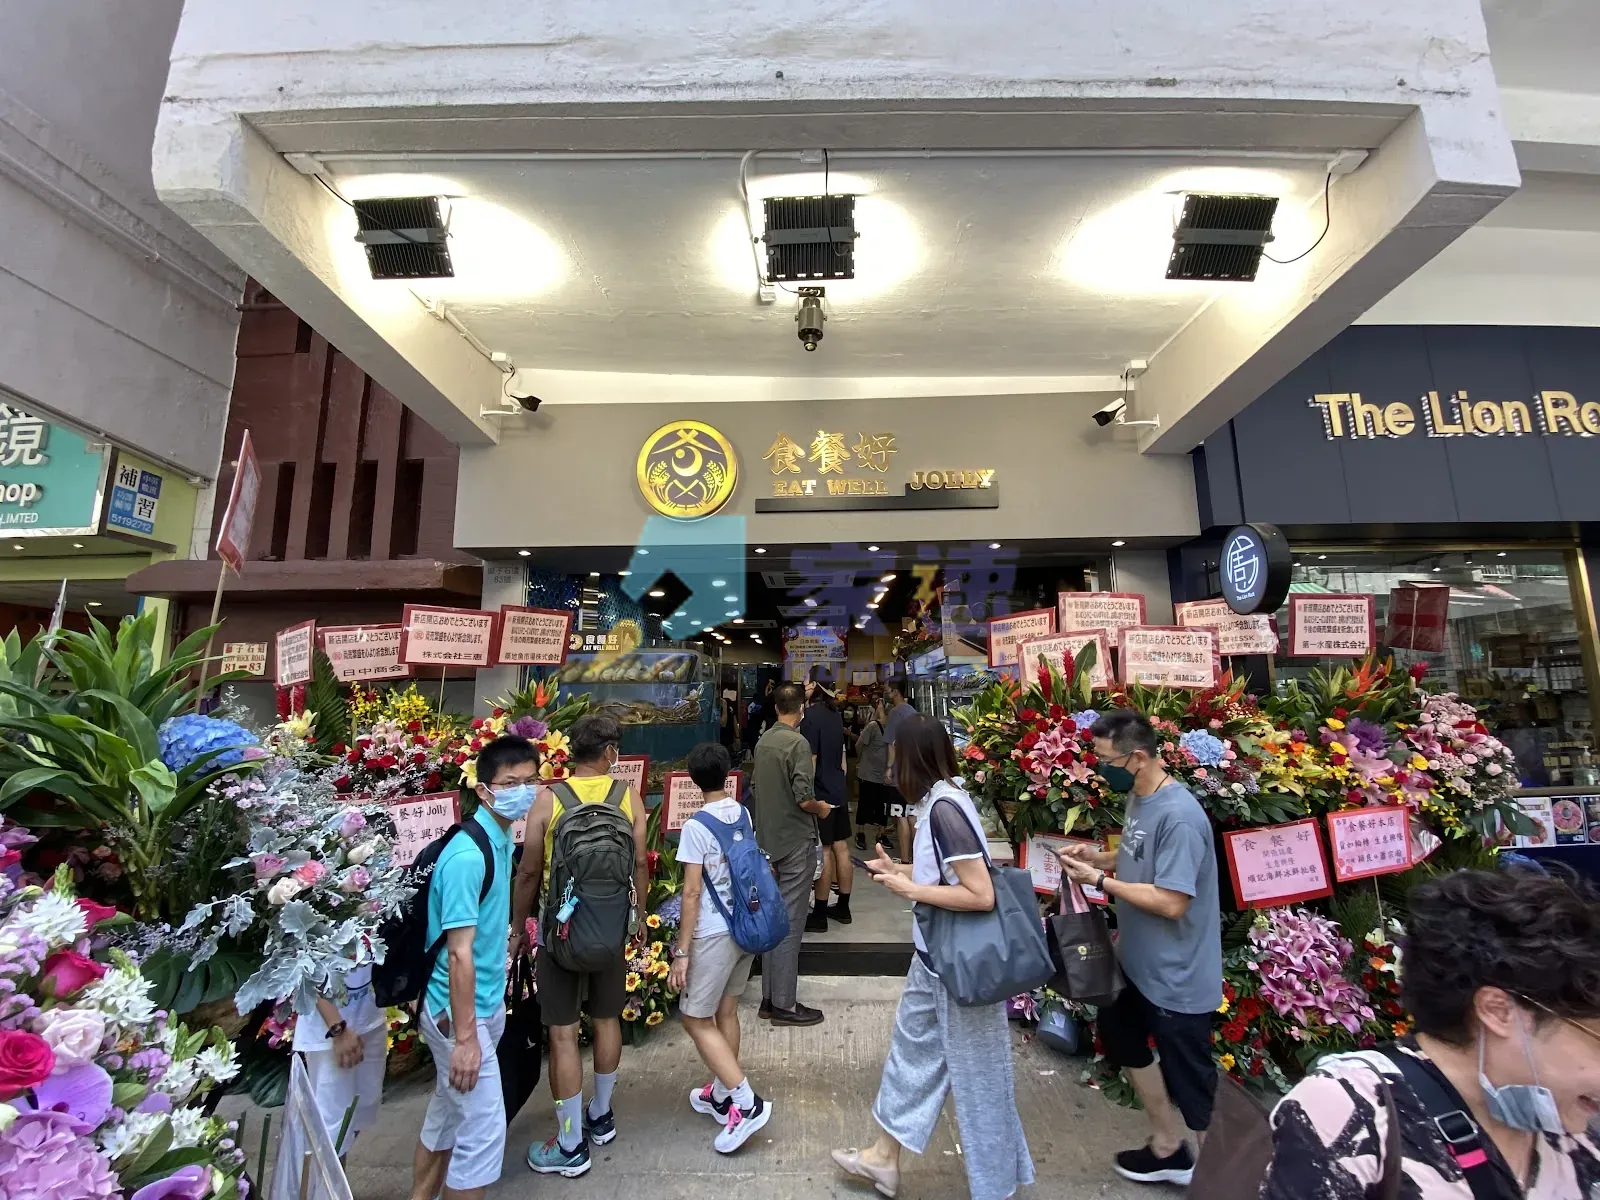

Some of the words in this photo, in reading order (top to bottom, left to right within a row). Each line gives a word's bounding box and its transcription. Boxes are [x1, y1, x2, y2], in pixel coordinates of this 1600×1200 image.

[1314, 392, 1416, 437] The
[1427, 391, 1533, 435] Lion
[761, 430, 899, 475] 食餐好
[119, 465, 138, 488] 補
[909, 469, 995, 491] JOLLY
[772, 480, 817, 496] EAT
[827, 479, 889, 495] WELL
[137, 498, 156, 519] 習
[110, 513, 152, 532] 51192712
[426, 804, 448, 816] Jolly
